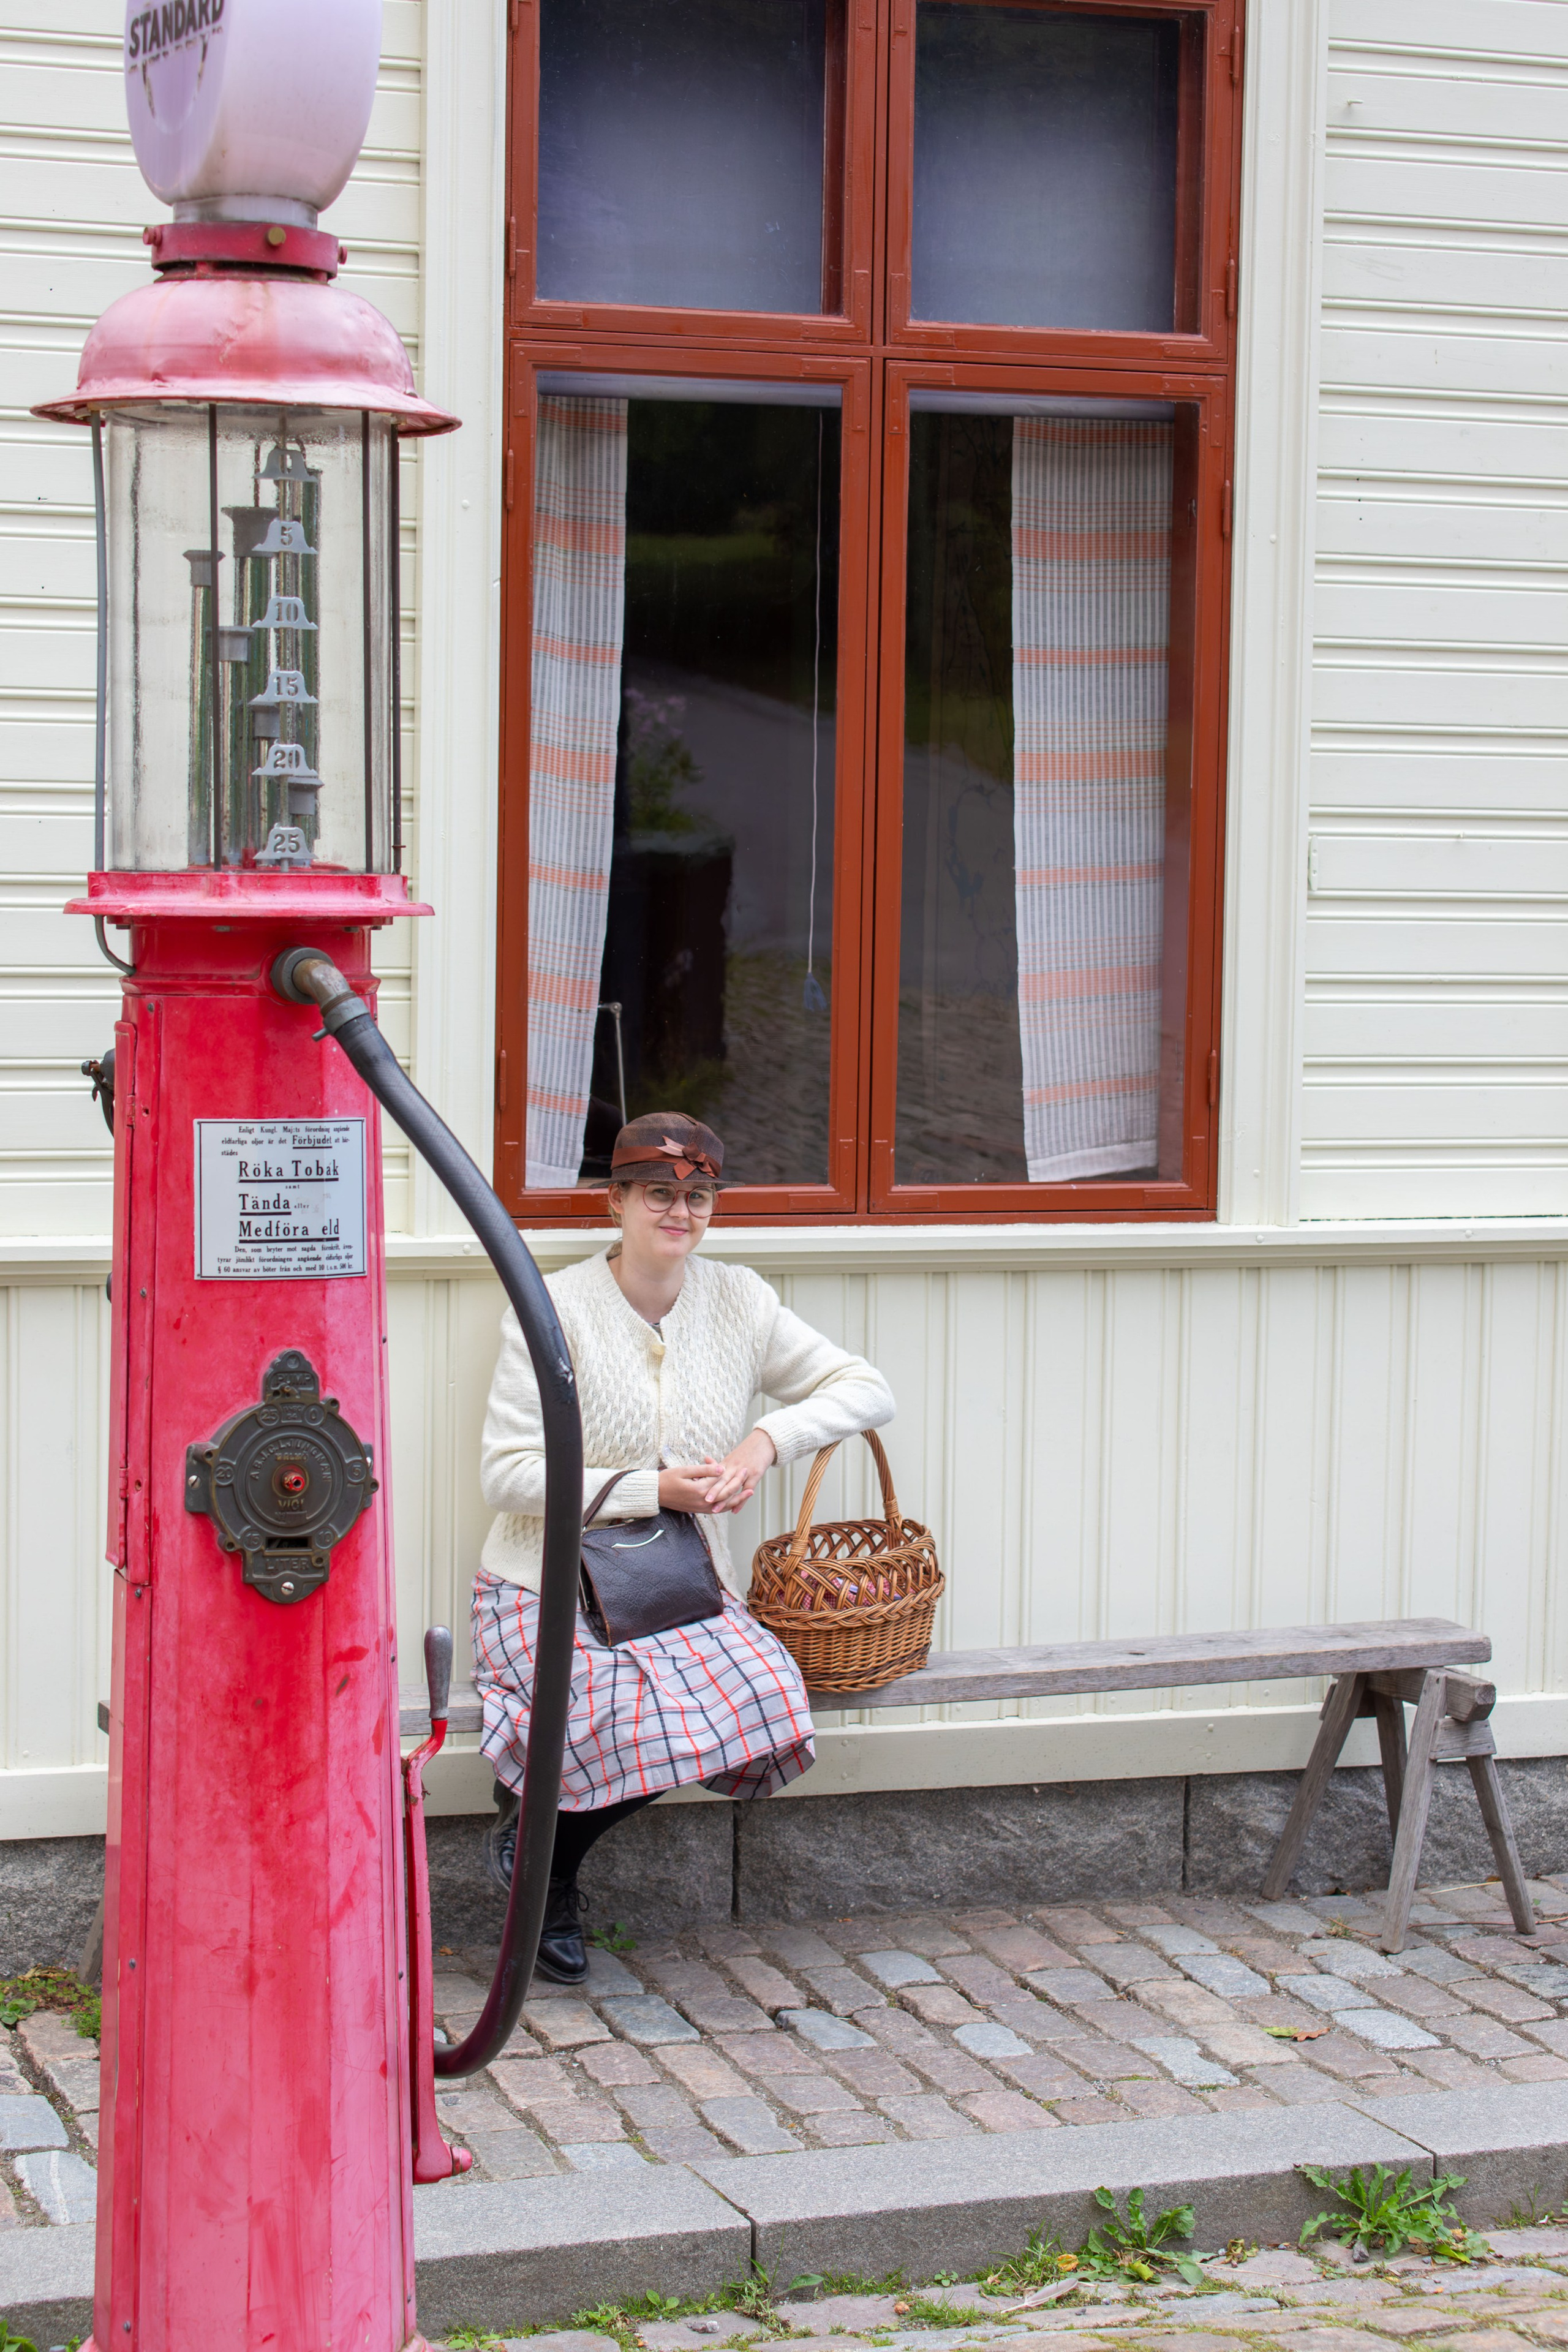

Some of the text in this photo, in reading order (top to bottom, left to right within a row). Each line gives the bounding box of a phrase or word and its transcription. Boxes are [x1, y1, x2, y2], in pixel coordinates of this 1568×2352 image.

[129, 0, 225, 58] STANDARD
[279, 526, 294, 546] 5
[274, 601, 300, 624] 10
[273, 676, 299, 696] 15
[273, 749, 301, 769] 20
[273, 834, 301, 853] 25
[222, 1137, 247, 1146] eldfarliga
[292, 1135, 332, 1147] Förbjudet
[239, 1159, 339, 1177] Röka Tobak
[239, 1193, 290, 1210] Tända
[239, 1218, 339, 1237] Medföra eld
[277, 1373, 312, 1385] PUMP
[262, 1409, 277, 1420] 25
[310, 1408, 318, 1420] 0
[215, 1466, 233, 1479] 20
[352, 1464, 361, 1477] 5
[246, 1533, 260, 1545] 15
[318, 1531, 332, 1542] 10
[266, 1558, 309, 1570] LITER
